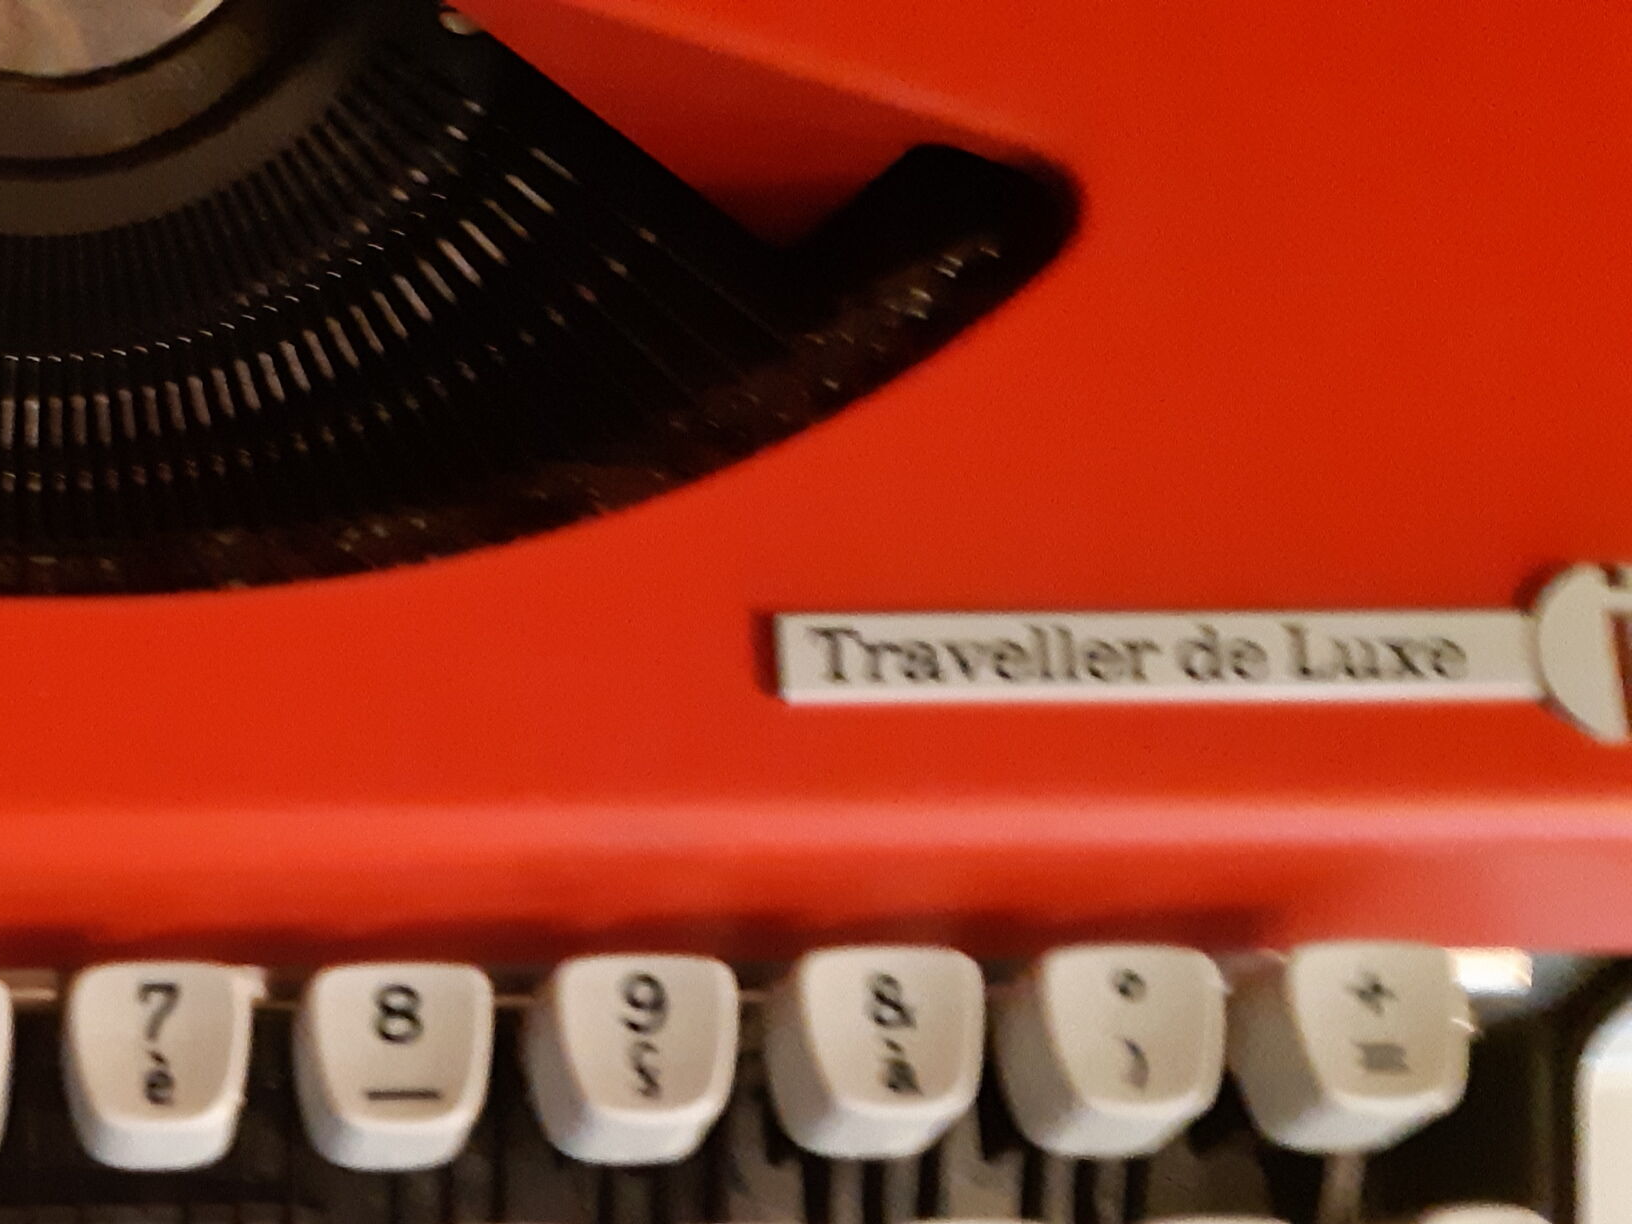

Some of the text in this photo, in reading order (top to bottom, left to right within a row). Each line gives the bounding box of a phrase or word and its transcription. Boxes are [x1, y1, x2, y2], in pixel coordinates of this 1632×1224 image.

[807, 622, 1470, 685] Traveller de Luxe
[138, 982, 181, 1041] 7
[376, 984, 422, 1044] 8
[625, 973, 667, 1035] 9
